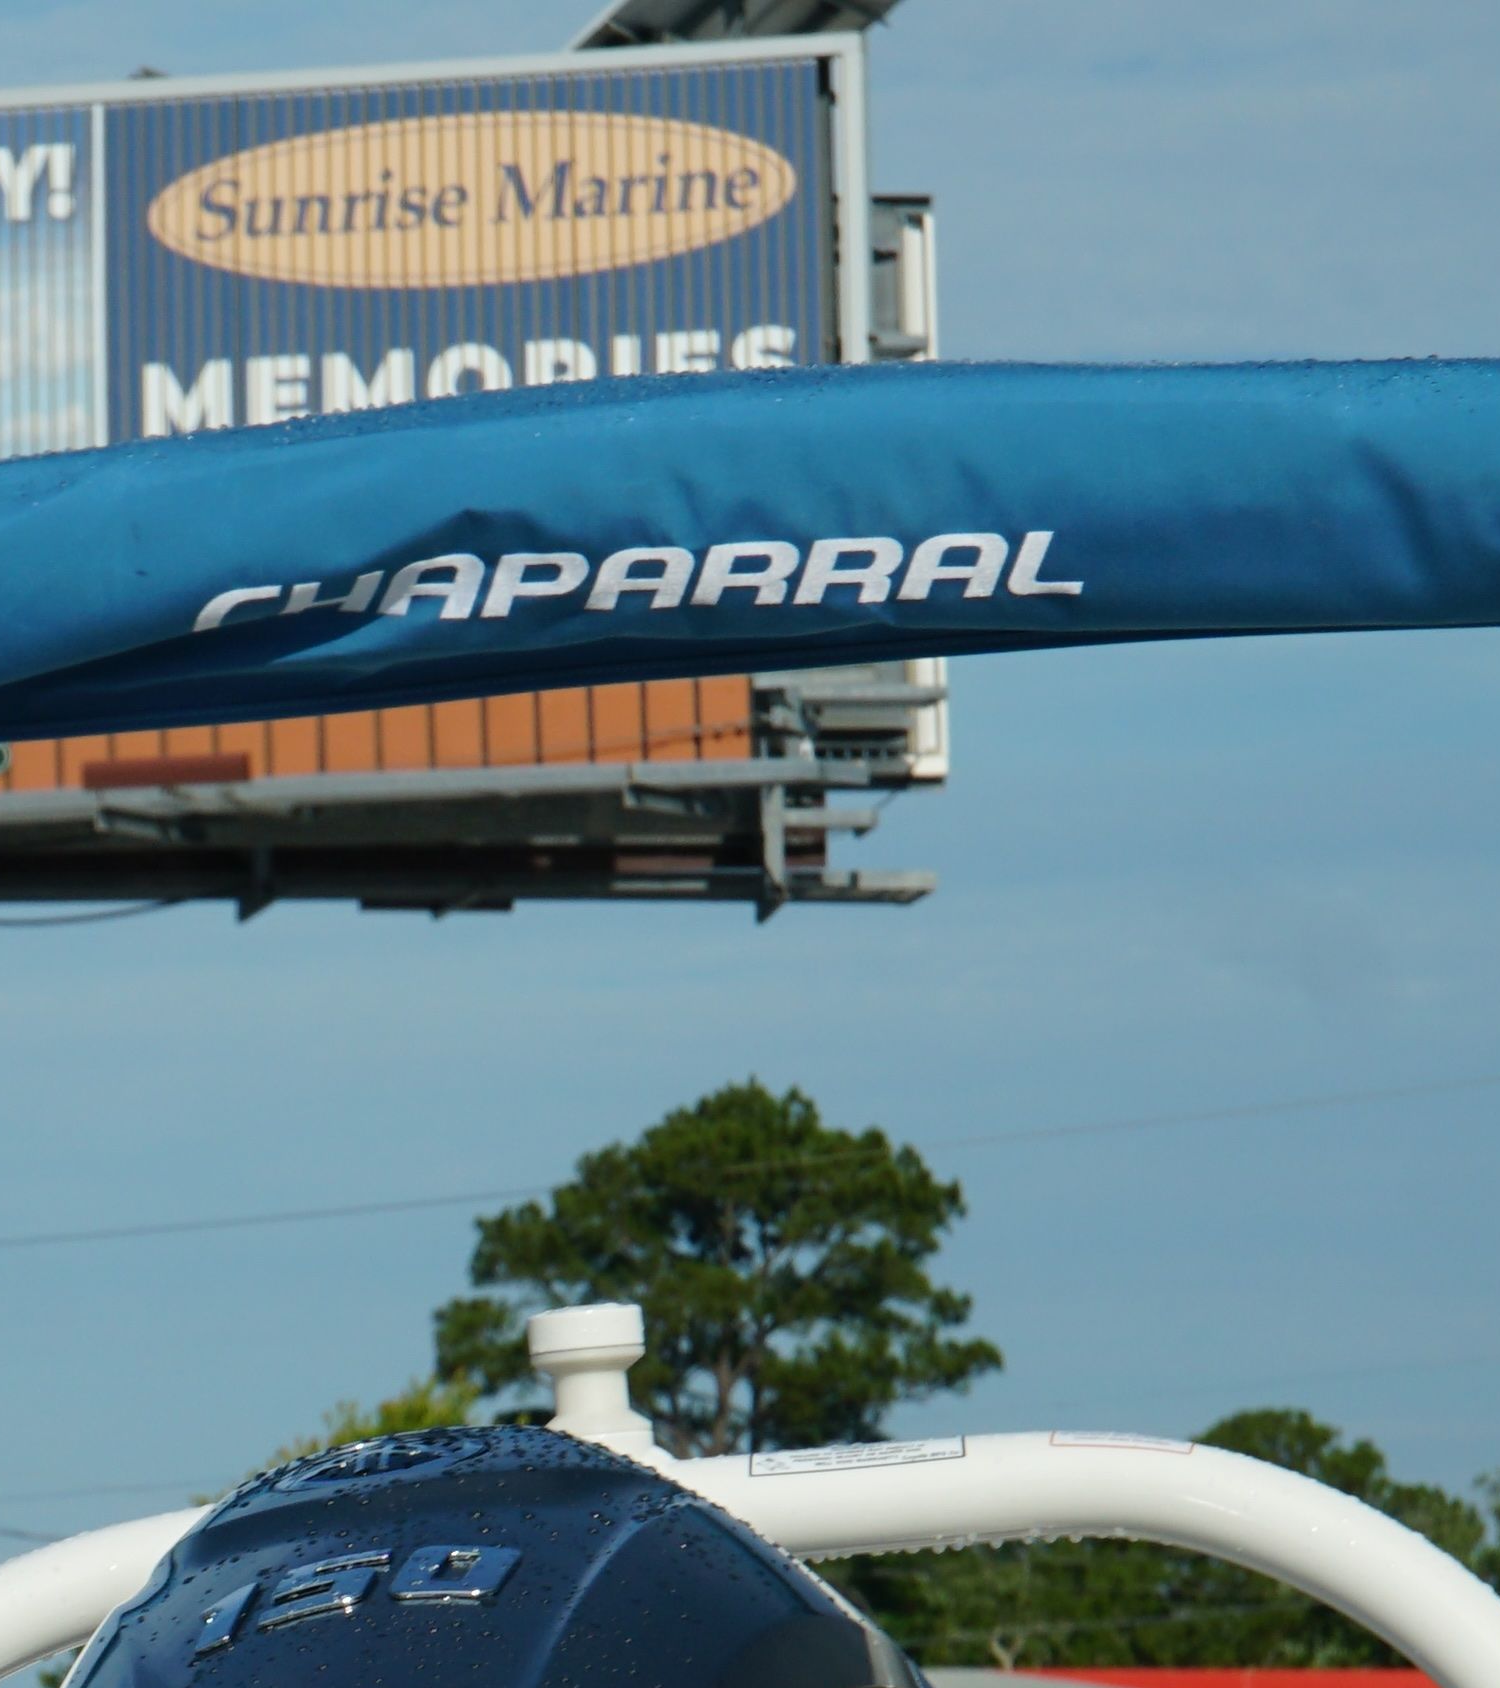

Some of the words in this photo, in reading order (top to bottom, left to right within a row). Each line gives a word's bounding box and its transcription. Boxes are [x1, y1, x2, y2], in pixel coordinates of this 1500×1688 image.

[193, 171, 469, 241] Sunrise
[492, 153, 760, 225] Marine
[189, 1546, 523, 1656] 150
